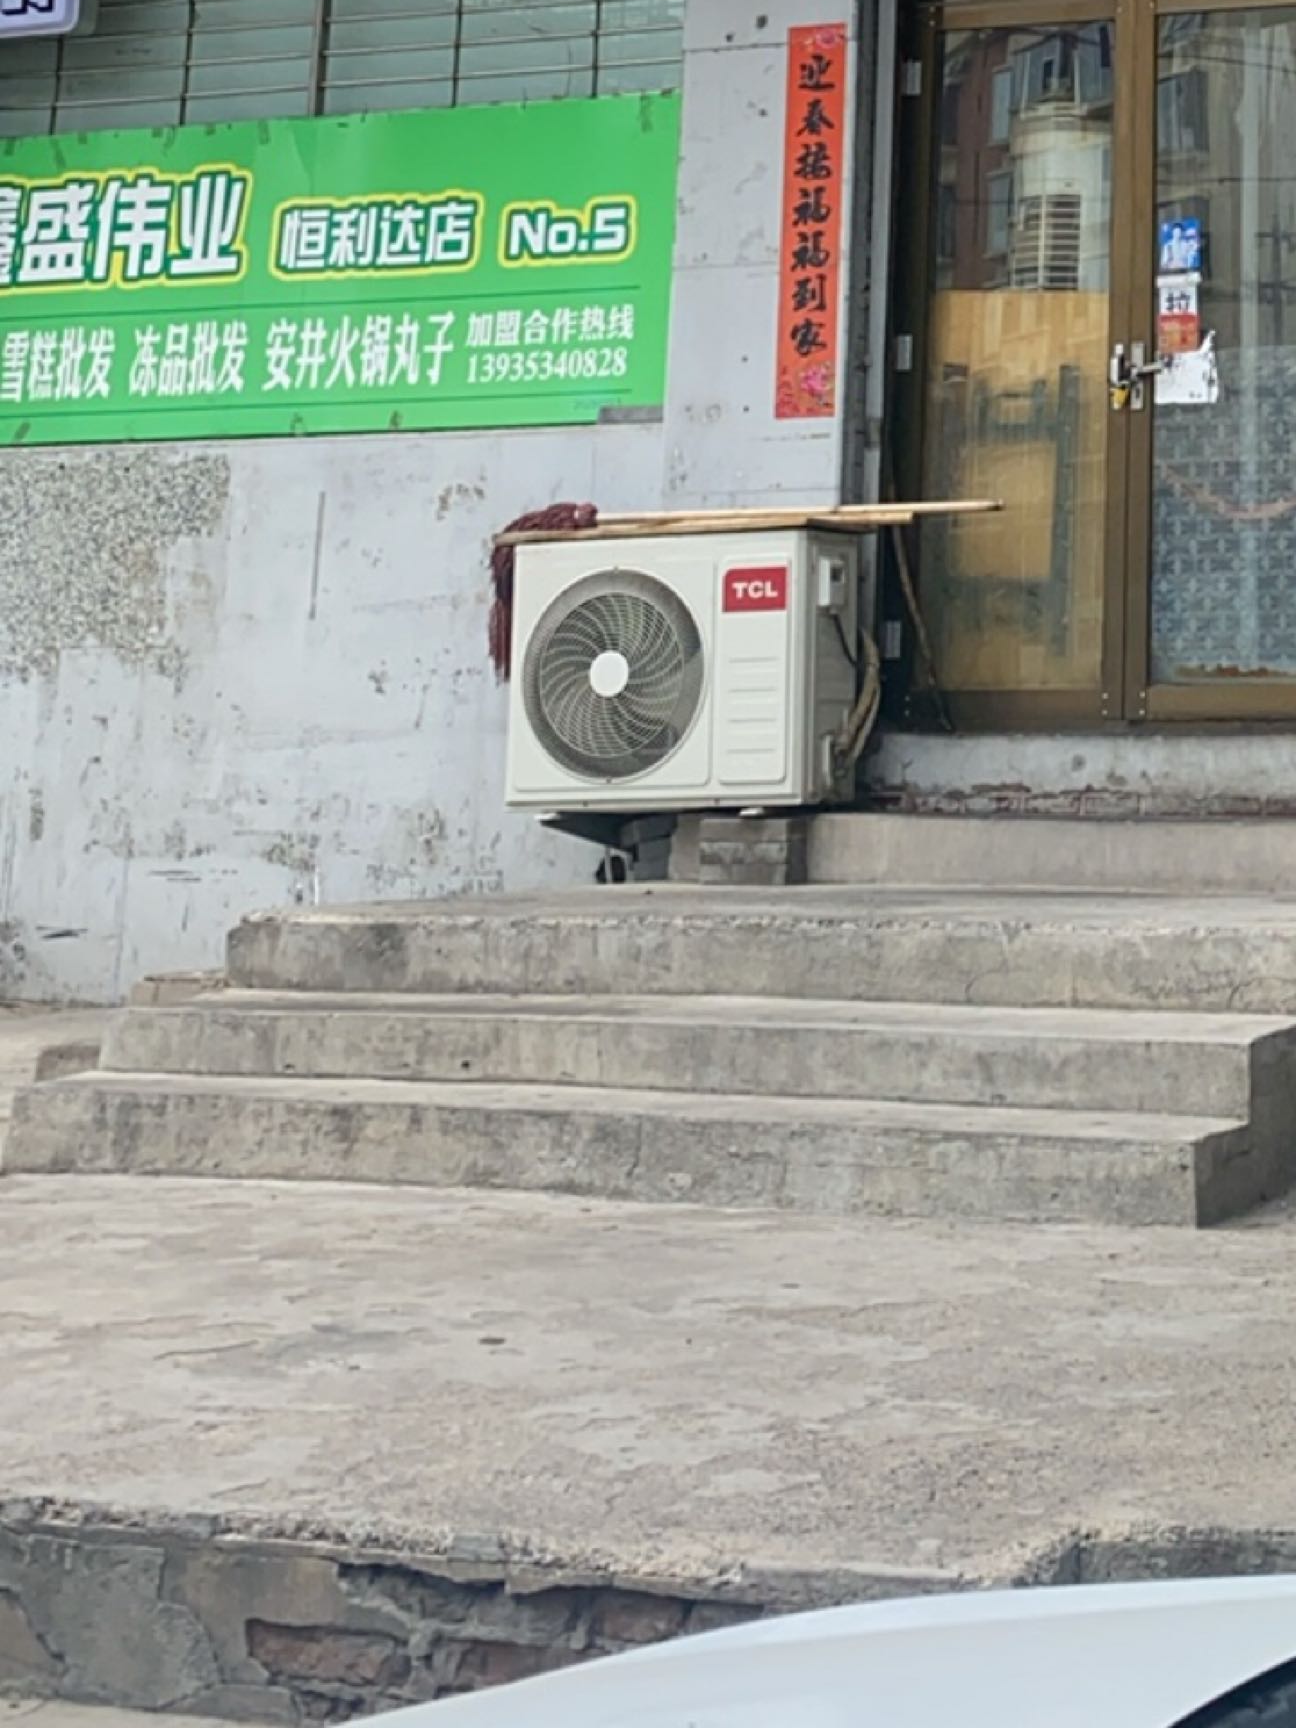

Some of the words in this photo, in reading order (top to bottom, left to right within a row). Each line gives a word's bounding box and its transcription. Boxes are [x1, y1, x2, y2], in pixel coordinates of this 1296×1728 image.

[280, 200, 474, 270] 恒利达店
[509, 207, 627, 257] No.5
[466, 303, 635, 347] 加盟合作热线
[0, 326, 115, 403] 雪糕批发
[129, 320, 248, 397] 冻品批发
[261, 310, 456, 391] 安井火锅丸子
[466, 346, 627, 383] 13935340828
[732, 580, 778, 599] TCL
